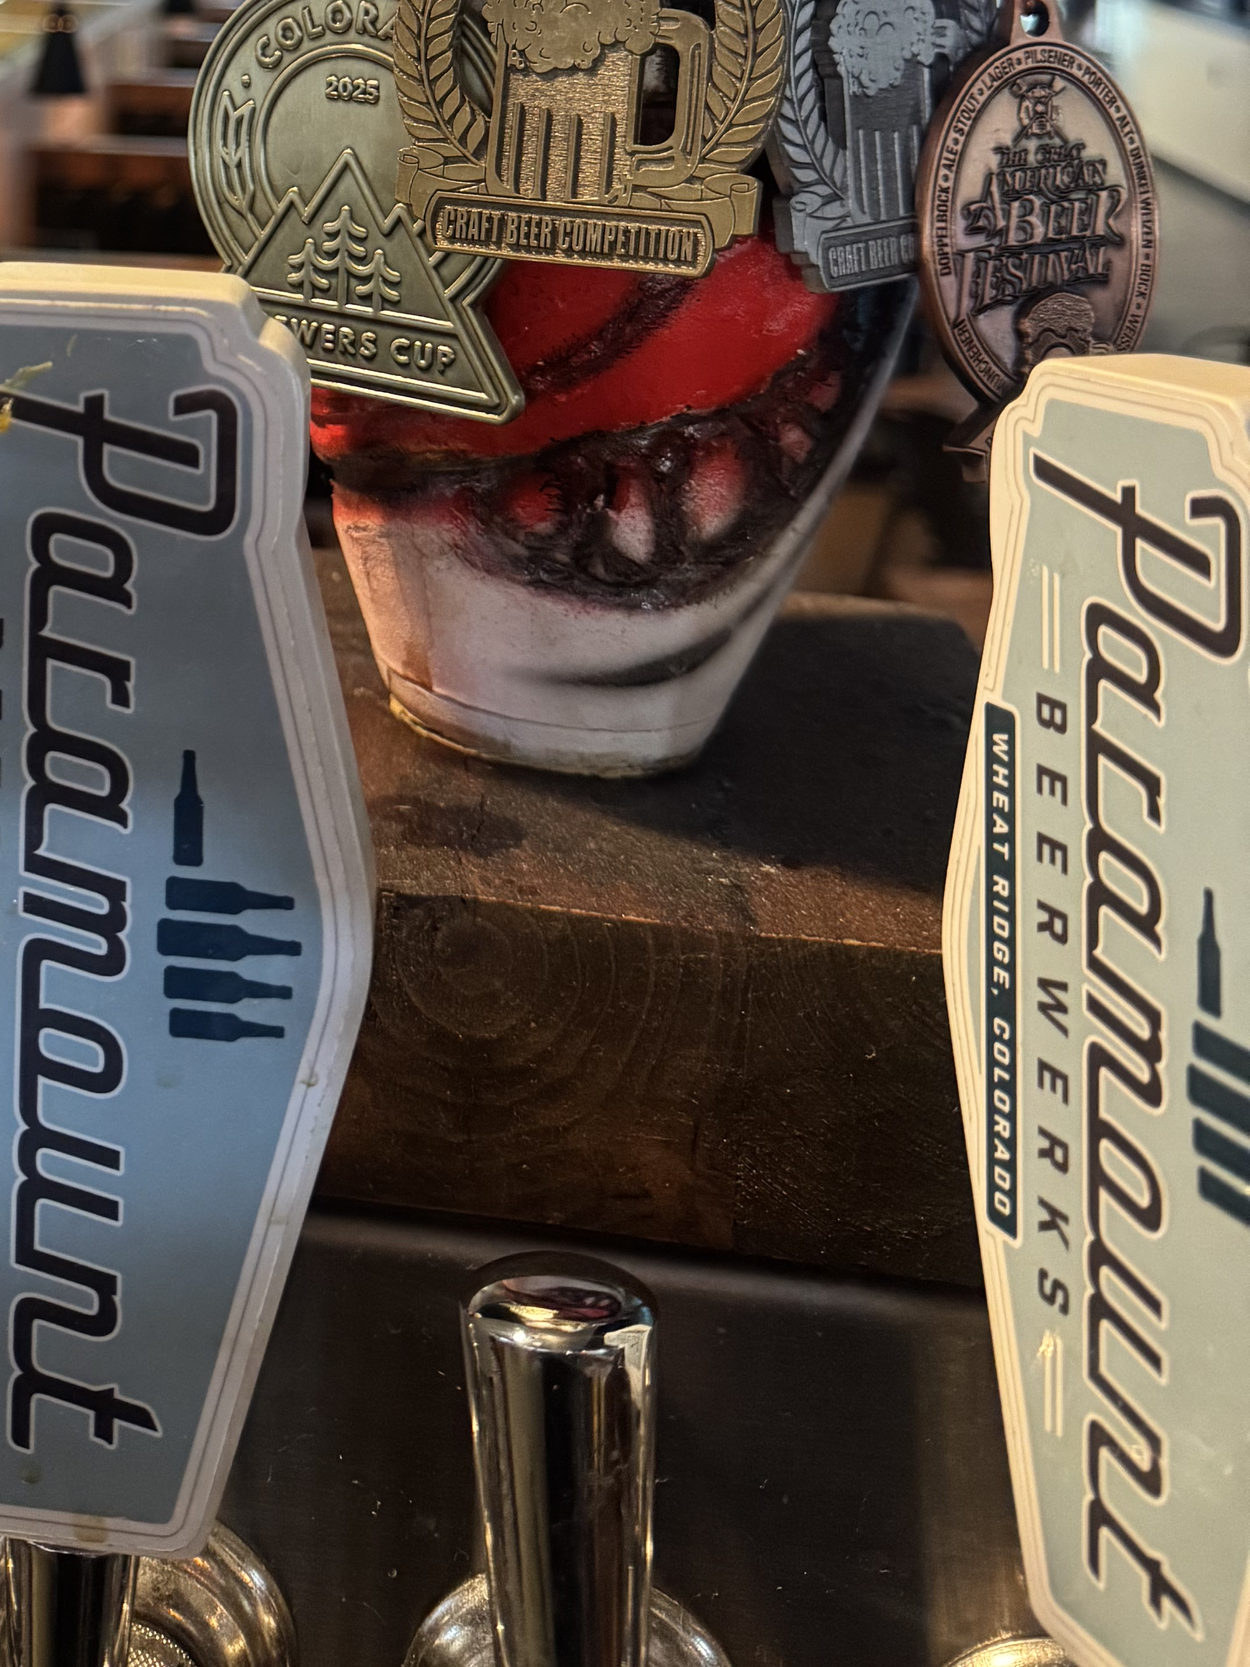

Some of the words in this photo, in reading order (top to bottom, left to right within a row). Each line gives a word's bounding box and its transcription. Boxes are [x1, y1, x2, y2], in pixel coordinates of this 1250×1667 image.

[982, 56, 1017, 94] LAGER
[1023, 48, 1076, 70] PILSENER
[325, 74, 380, 104] 2025
[1081, 67, 1118, 112] PORTER
[953, 93, 981, 138] STOUT
[1115, 114, 1133, 139] ALT
[942, 145, 959, 169] ALE
[443, 206, 500, 242] CRAFT
[505, 213, 551, 248] BEER
[557, 217, 694, 262] COMPETITION
[935, 185, 952, 277] DOPPELBOCK
[1003, 185, 1125, 248] BEER
[1135, 262, 1153, 300] BOCK
[390, 337, 456, 373] CUP
[989, 731, 1015, 862] WHEAT
[990, 875, 1014, 997] RIDGE,
[1033, 690, 1070, 1317] BEERWERKS
[1031, 449, 1245, 1639] Paramount
[990, 1020, 1014, 1216] COLORADO
